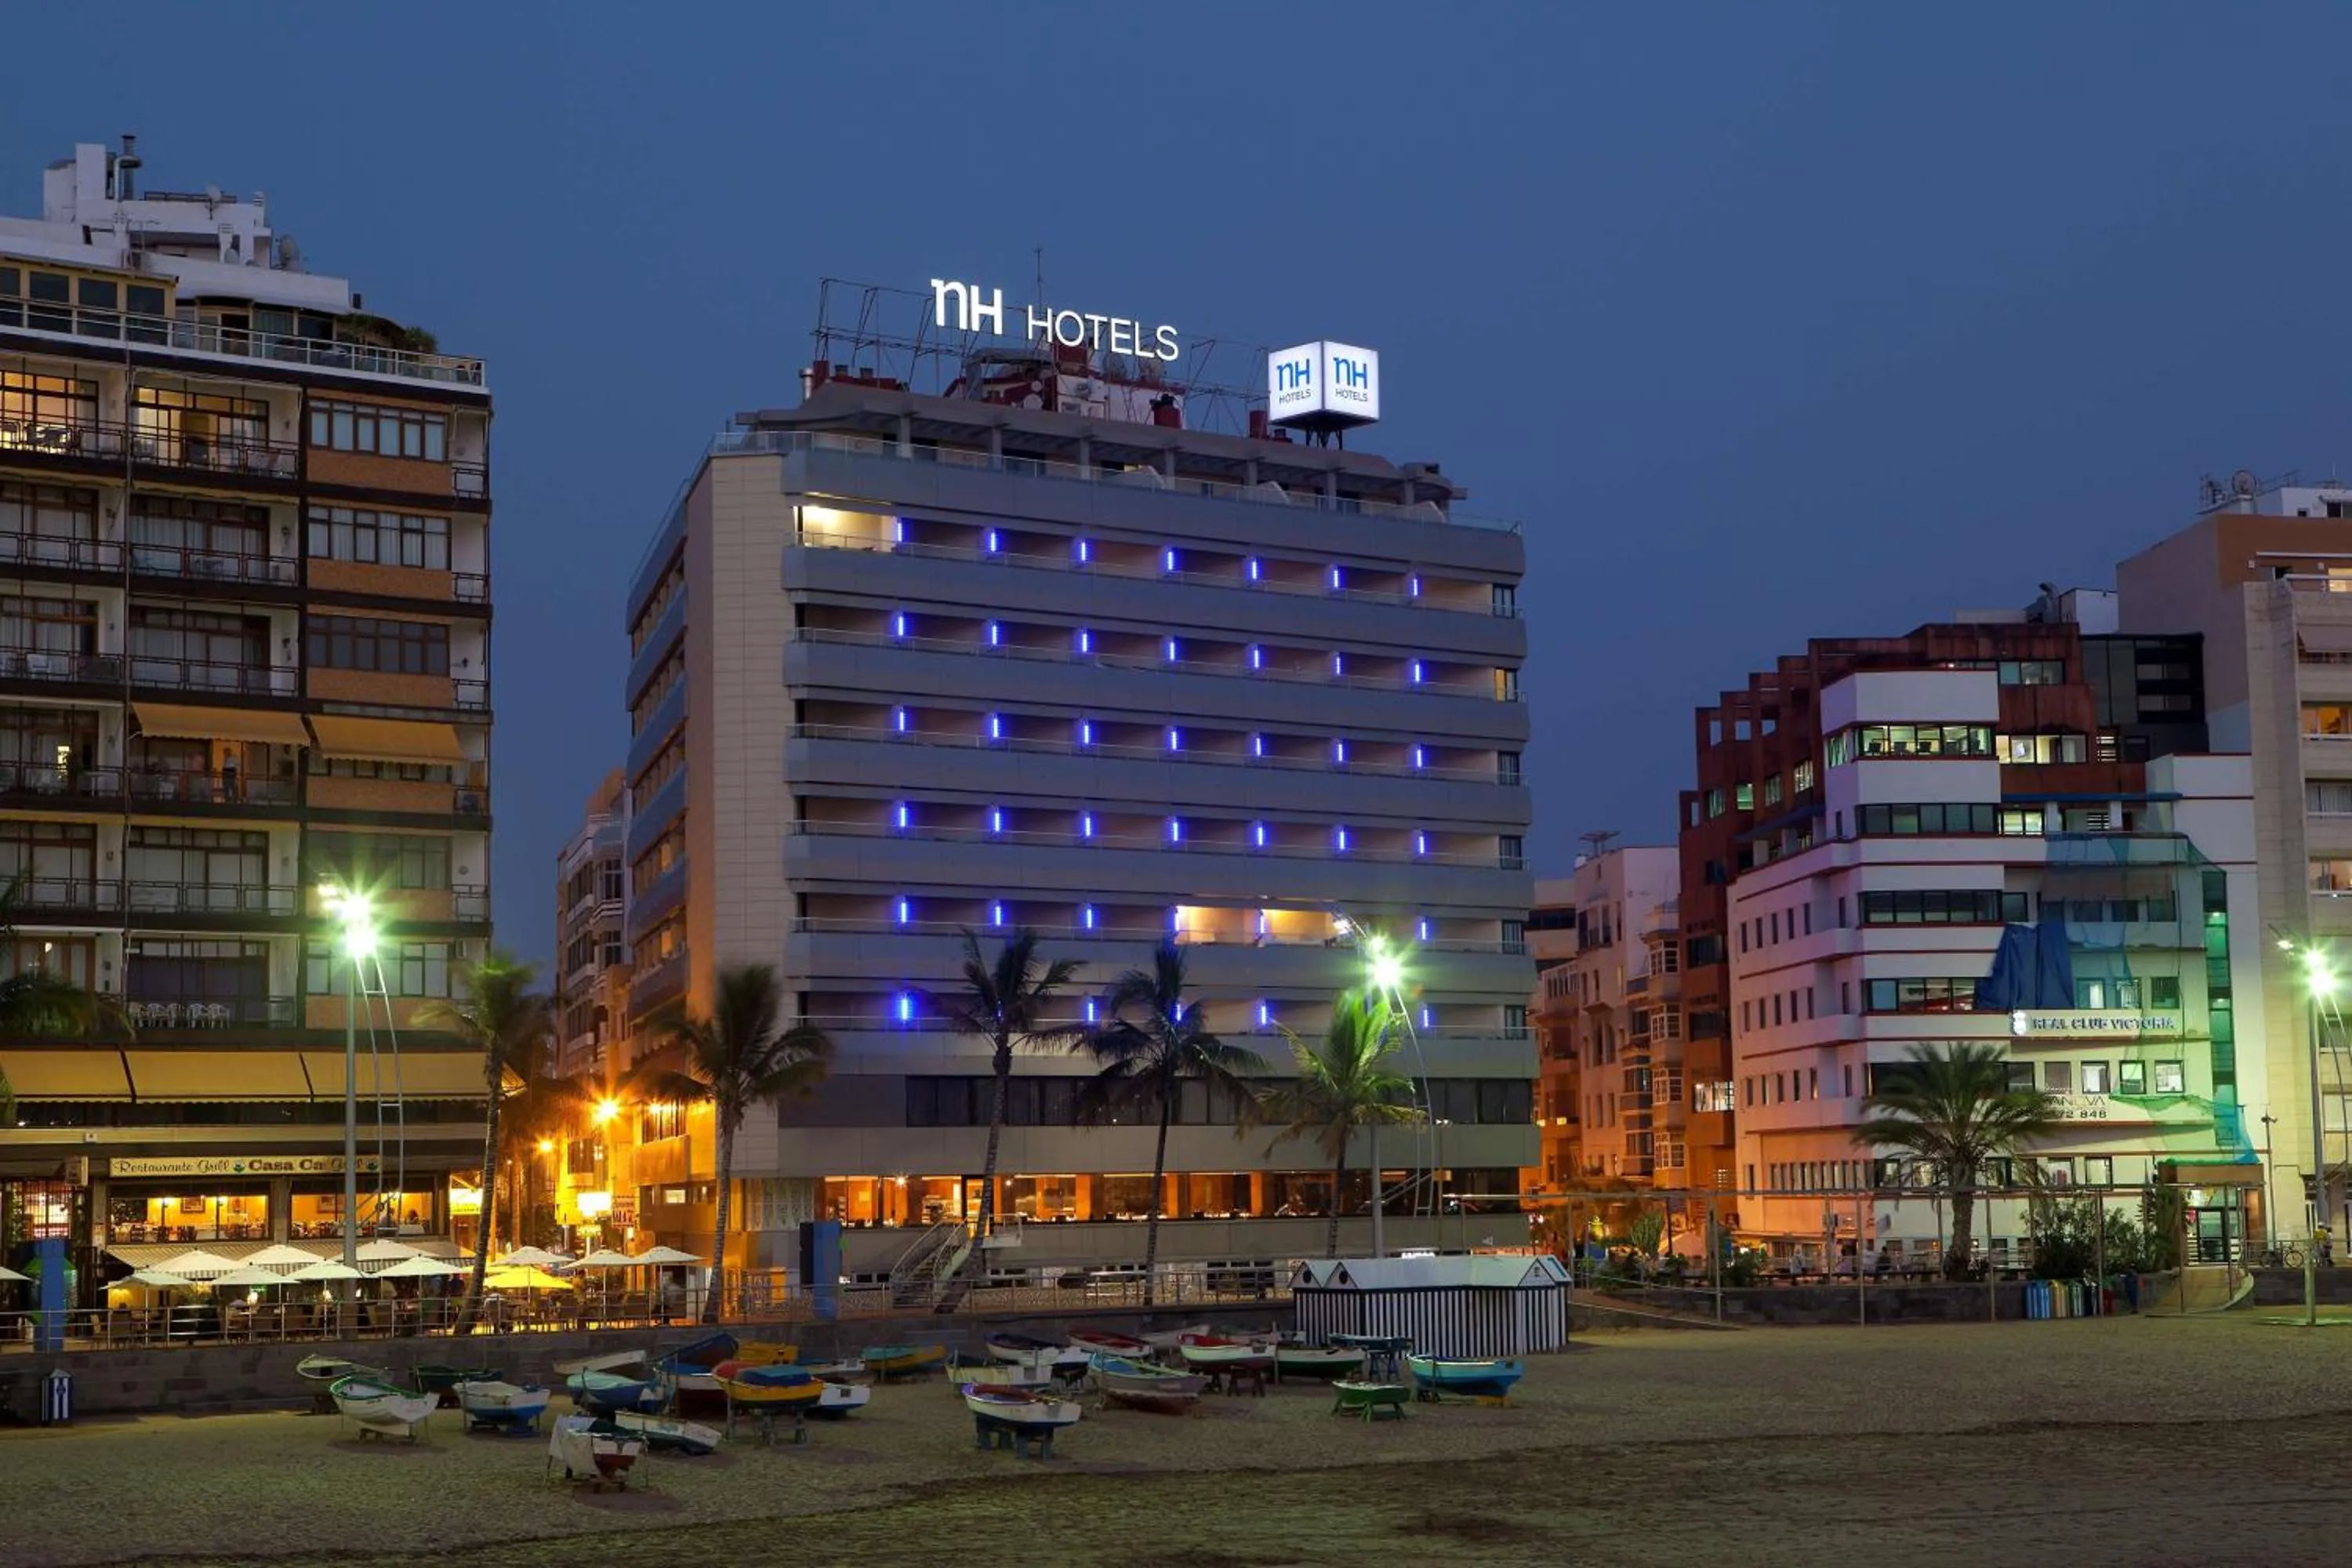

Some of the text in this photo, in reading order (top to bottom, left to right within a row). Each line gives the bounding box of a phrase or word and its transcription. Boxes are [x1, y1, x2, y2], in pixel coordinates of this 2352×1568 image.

[1028, 304, 1178, 361] HOTELS
[1279, 388, 1311, 405] HOTELS
[1335, 388, 1368, 402] HOTELS
[2032, 1017, 2067, 1029] REAL
[2111, 1016, 2175, 1029] VICTORIA
[112, 1159, 193, 1174] Restaurante
[197, 1159, 230, 1174] Grill
[249, 1159, 294, 1171] Casa
